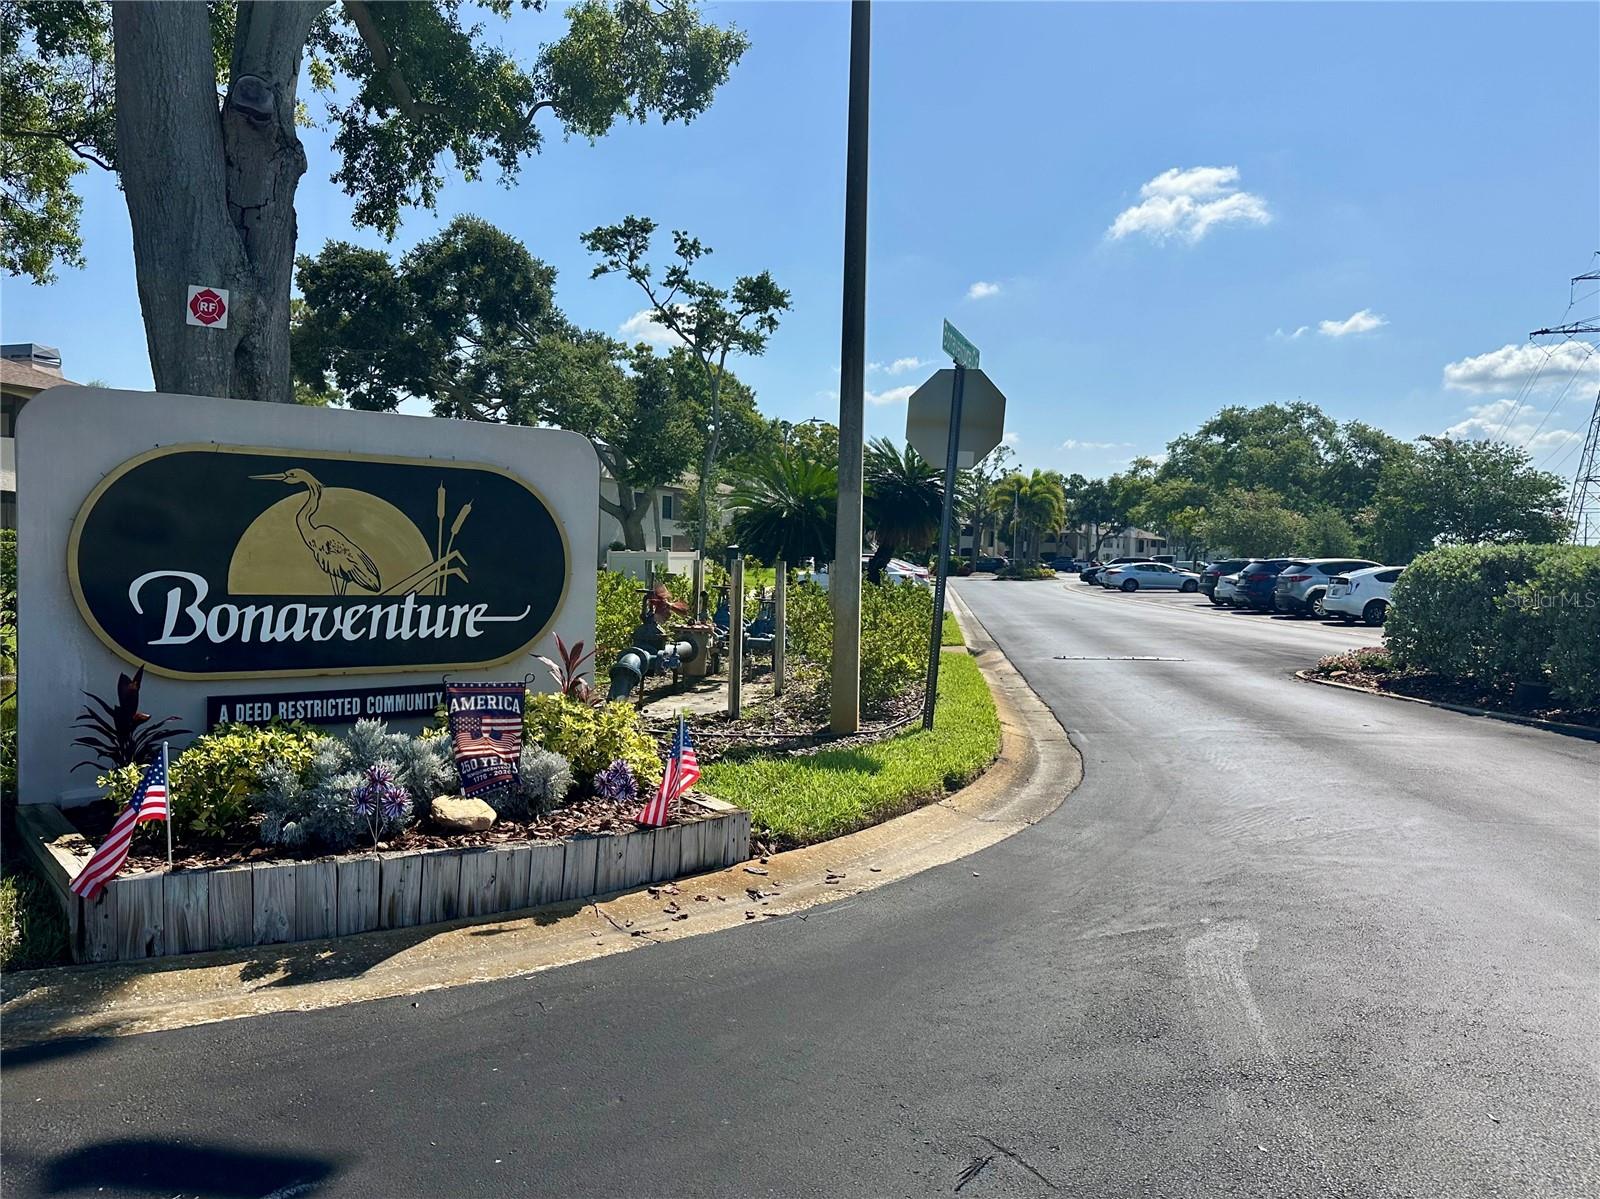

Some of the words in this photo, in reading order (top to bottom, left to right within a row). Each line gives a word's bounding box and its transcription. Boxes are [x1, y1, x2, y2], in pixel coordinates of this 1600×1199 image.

[200, 301, 216, 312] RF
[128, 570, 531, 645] Bonaventure
[219, 704, 228, 723] A
[235, 702, 272, 722] DEED
[278, 697, 361, 720] RESTRICTED
[366, 691, 443, 714] COMMUNITY
[449, 695, 521, 714] AMERICA
[460, 758, 478, 774] 250
[473, 773, 488, 783] 1776
